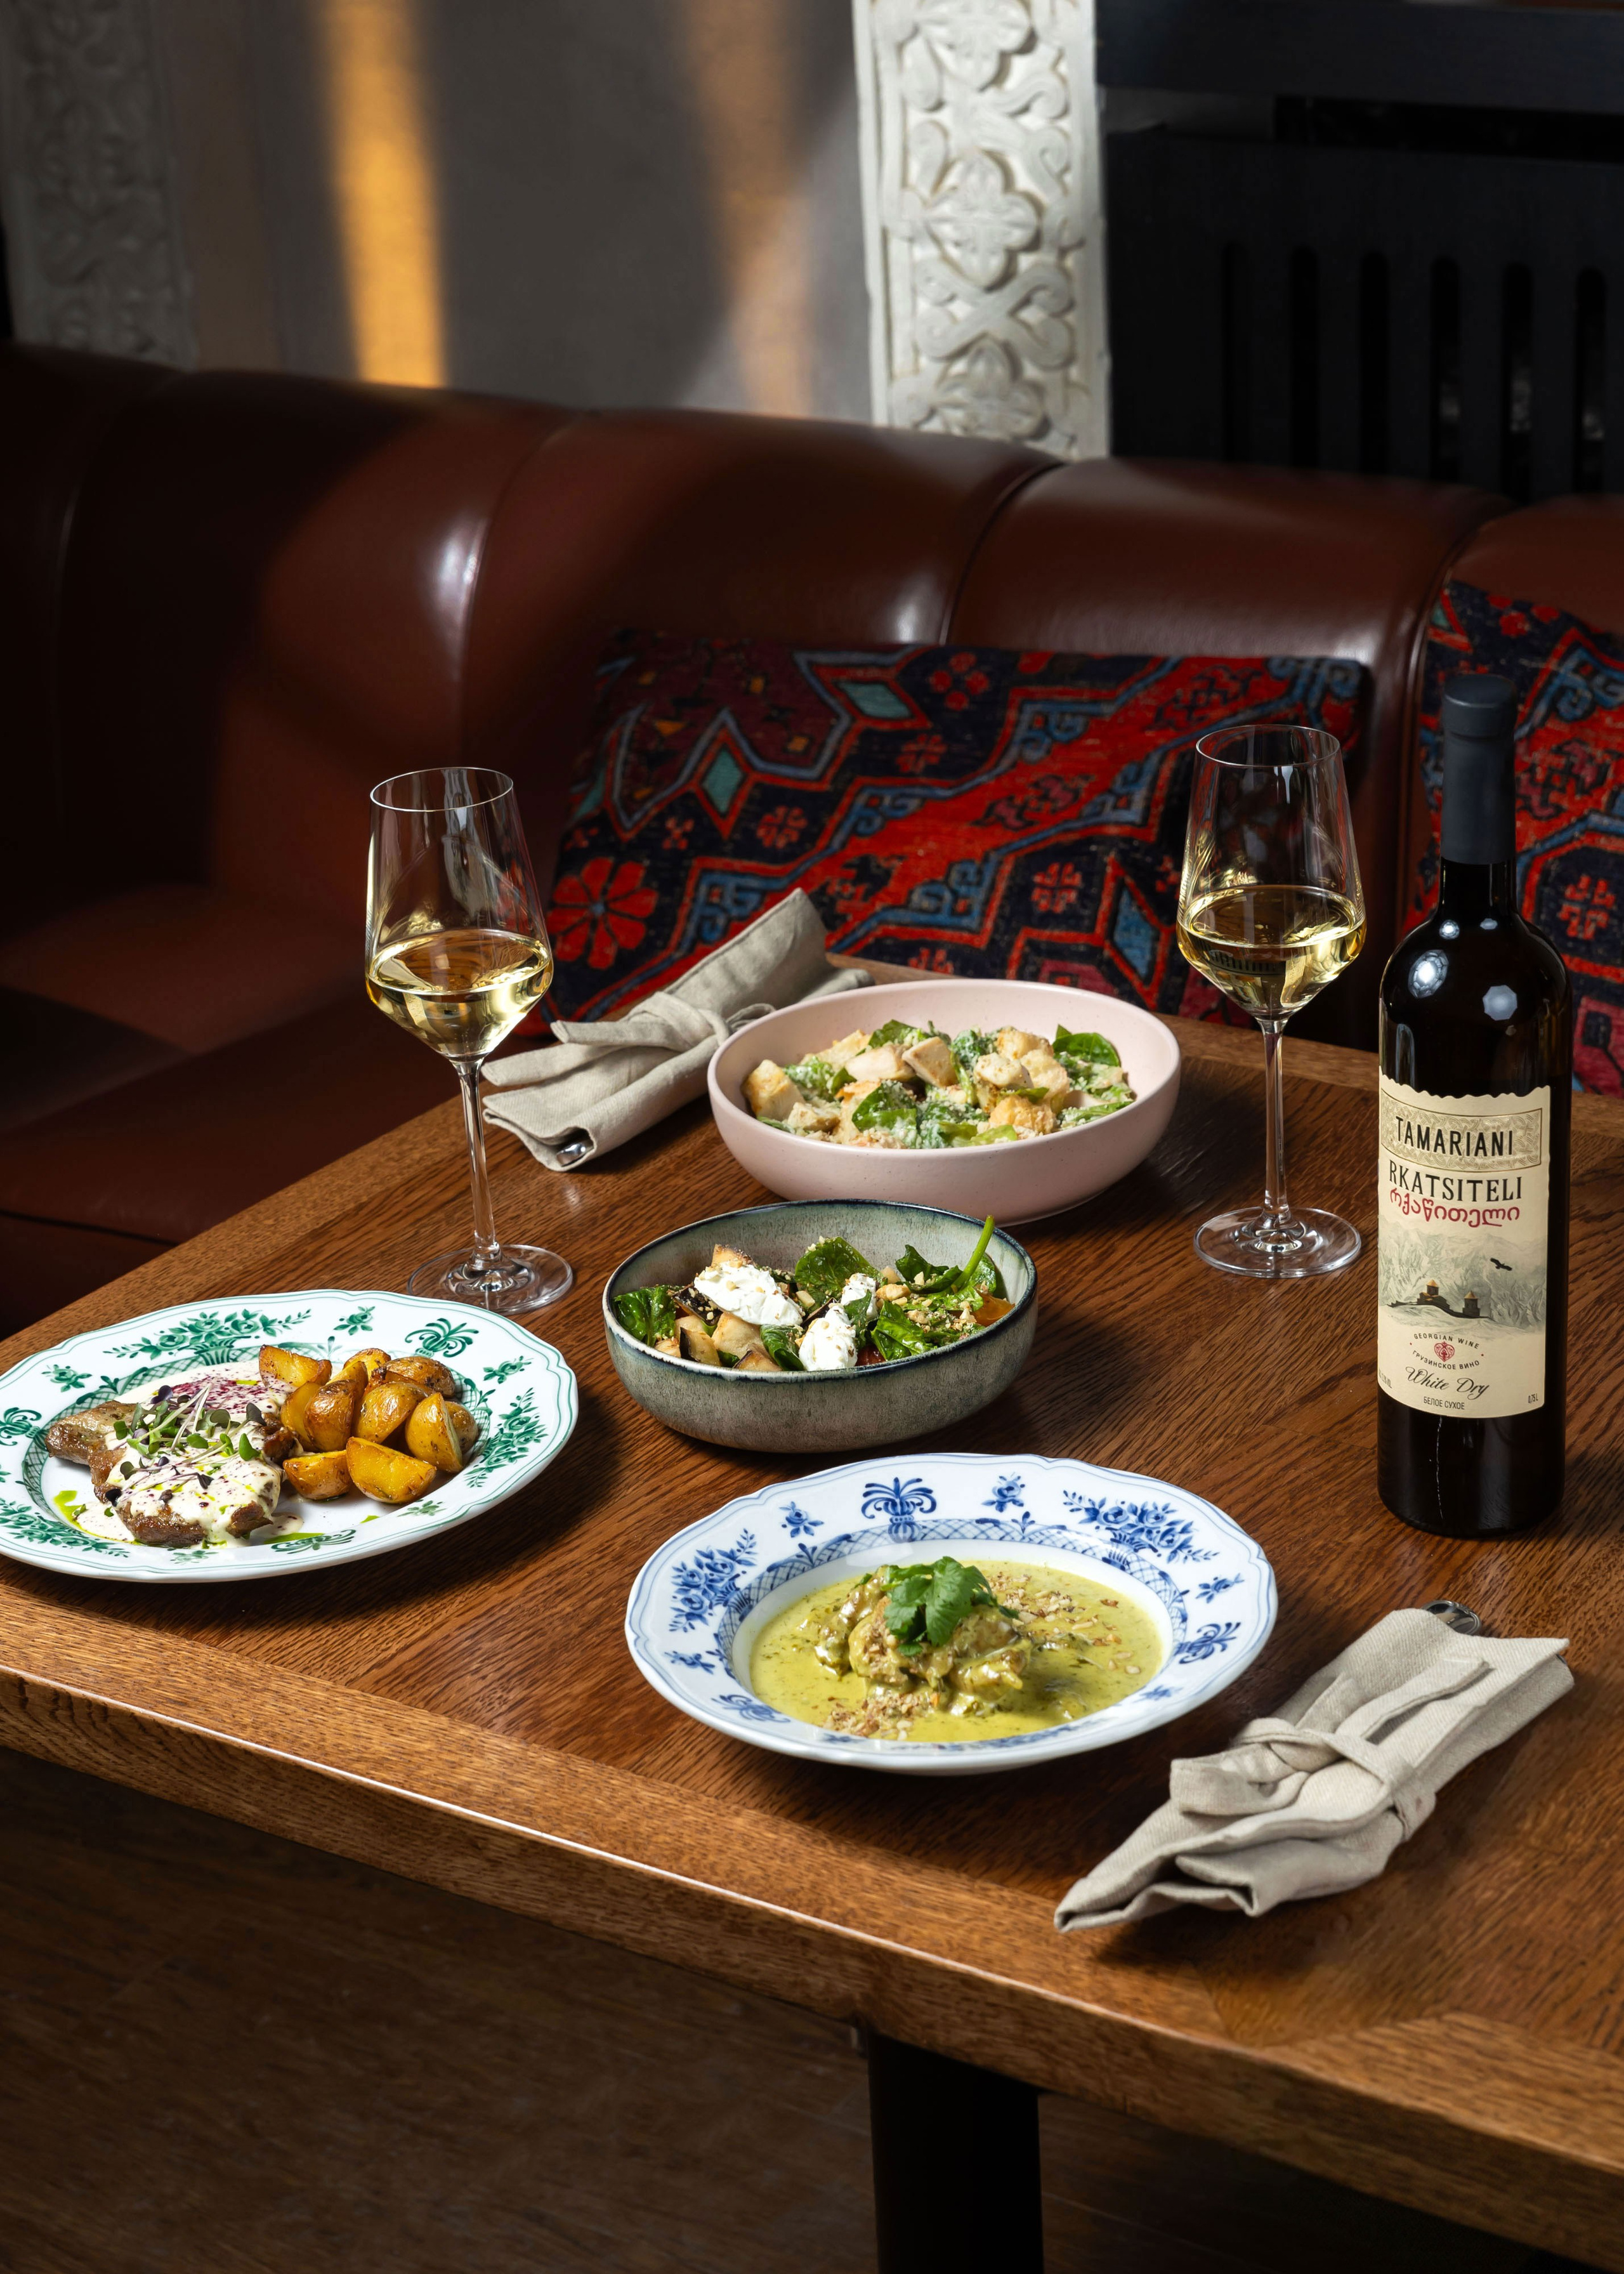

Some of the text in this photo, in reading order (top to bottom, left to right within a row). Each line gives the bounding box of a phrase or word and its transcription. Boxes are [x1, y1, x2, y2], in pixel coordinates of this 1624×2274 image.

[1396, 1116, 1513, 1157] TAMARIANI
[1389, 1159, 1522, 1202] RKATSITELI
[1390, 1188, 1520, 1228] რქაწითელი
[1413, 1333, 1479, 1350] GEORGIAN WINE
[1412, 1350, 1480, 1370] ГРУЗИНСКОЕ ВИНО
[1405, 1366, 1450, 1390] White
[1456, 1377, 1490, 1400] Dry
[1423, 1396, 1465, 1410] БЕЛОЕ СУХОЕ
